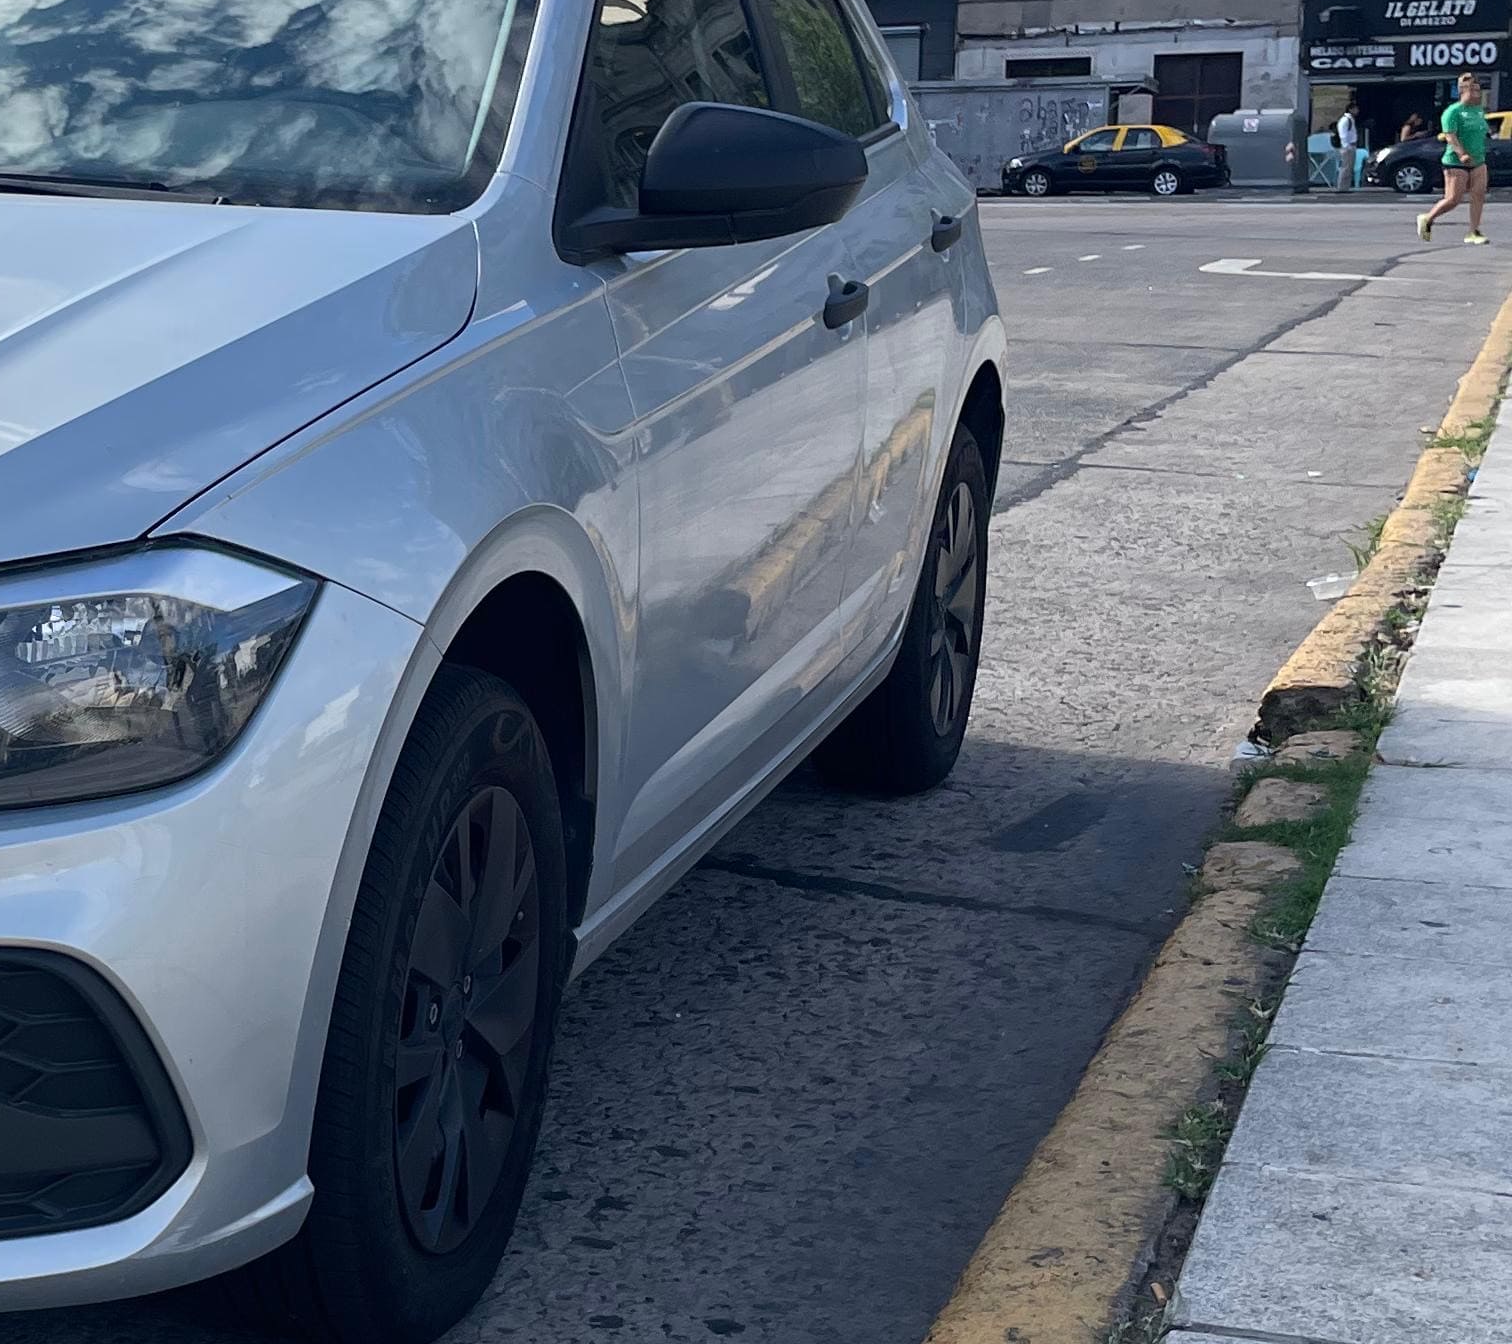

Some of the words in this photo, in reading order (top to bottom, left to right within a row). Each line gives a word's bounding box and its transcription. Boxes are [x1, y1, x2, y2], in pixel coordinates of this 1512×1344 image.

[1385, 1, 1405, 18] IL
[1406, 0, 1476, 17] GELATO
[1400, 17, 1412, 27] DI
[1410, 41, 1498, 67] KIOSCO
[1310, 57, 1395, 69] CAFE
